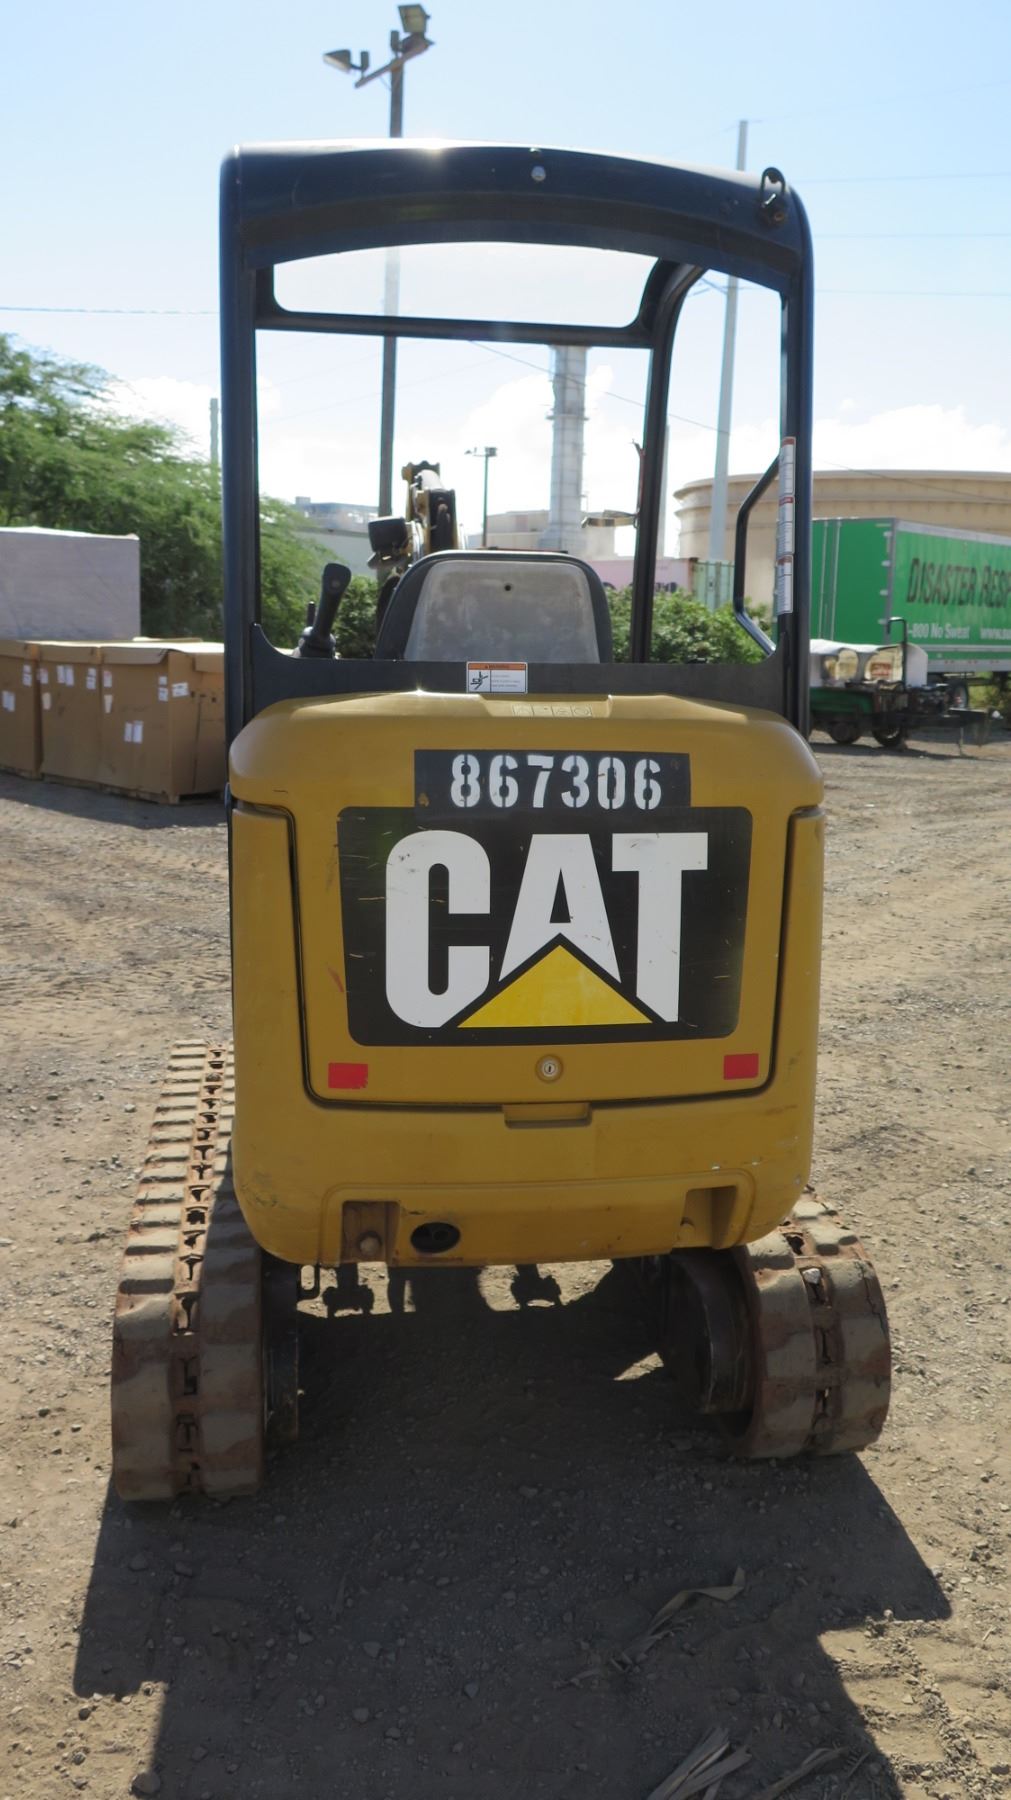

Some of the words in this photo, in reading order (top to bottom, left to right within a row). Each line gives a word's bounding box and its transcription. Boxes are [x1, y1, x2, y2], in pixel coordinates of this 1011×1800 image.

[906, 558, 977, 606] DISASTER
[450, 753, 662, 811] 867306
[385, 829, 709, 1028] CAT
